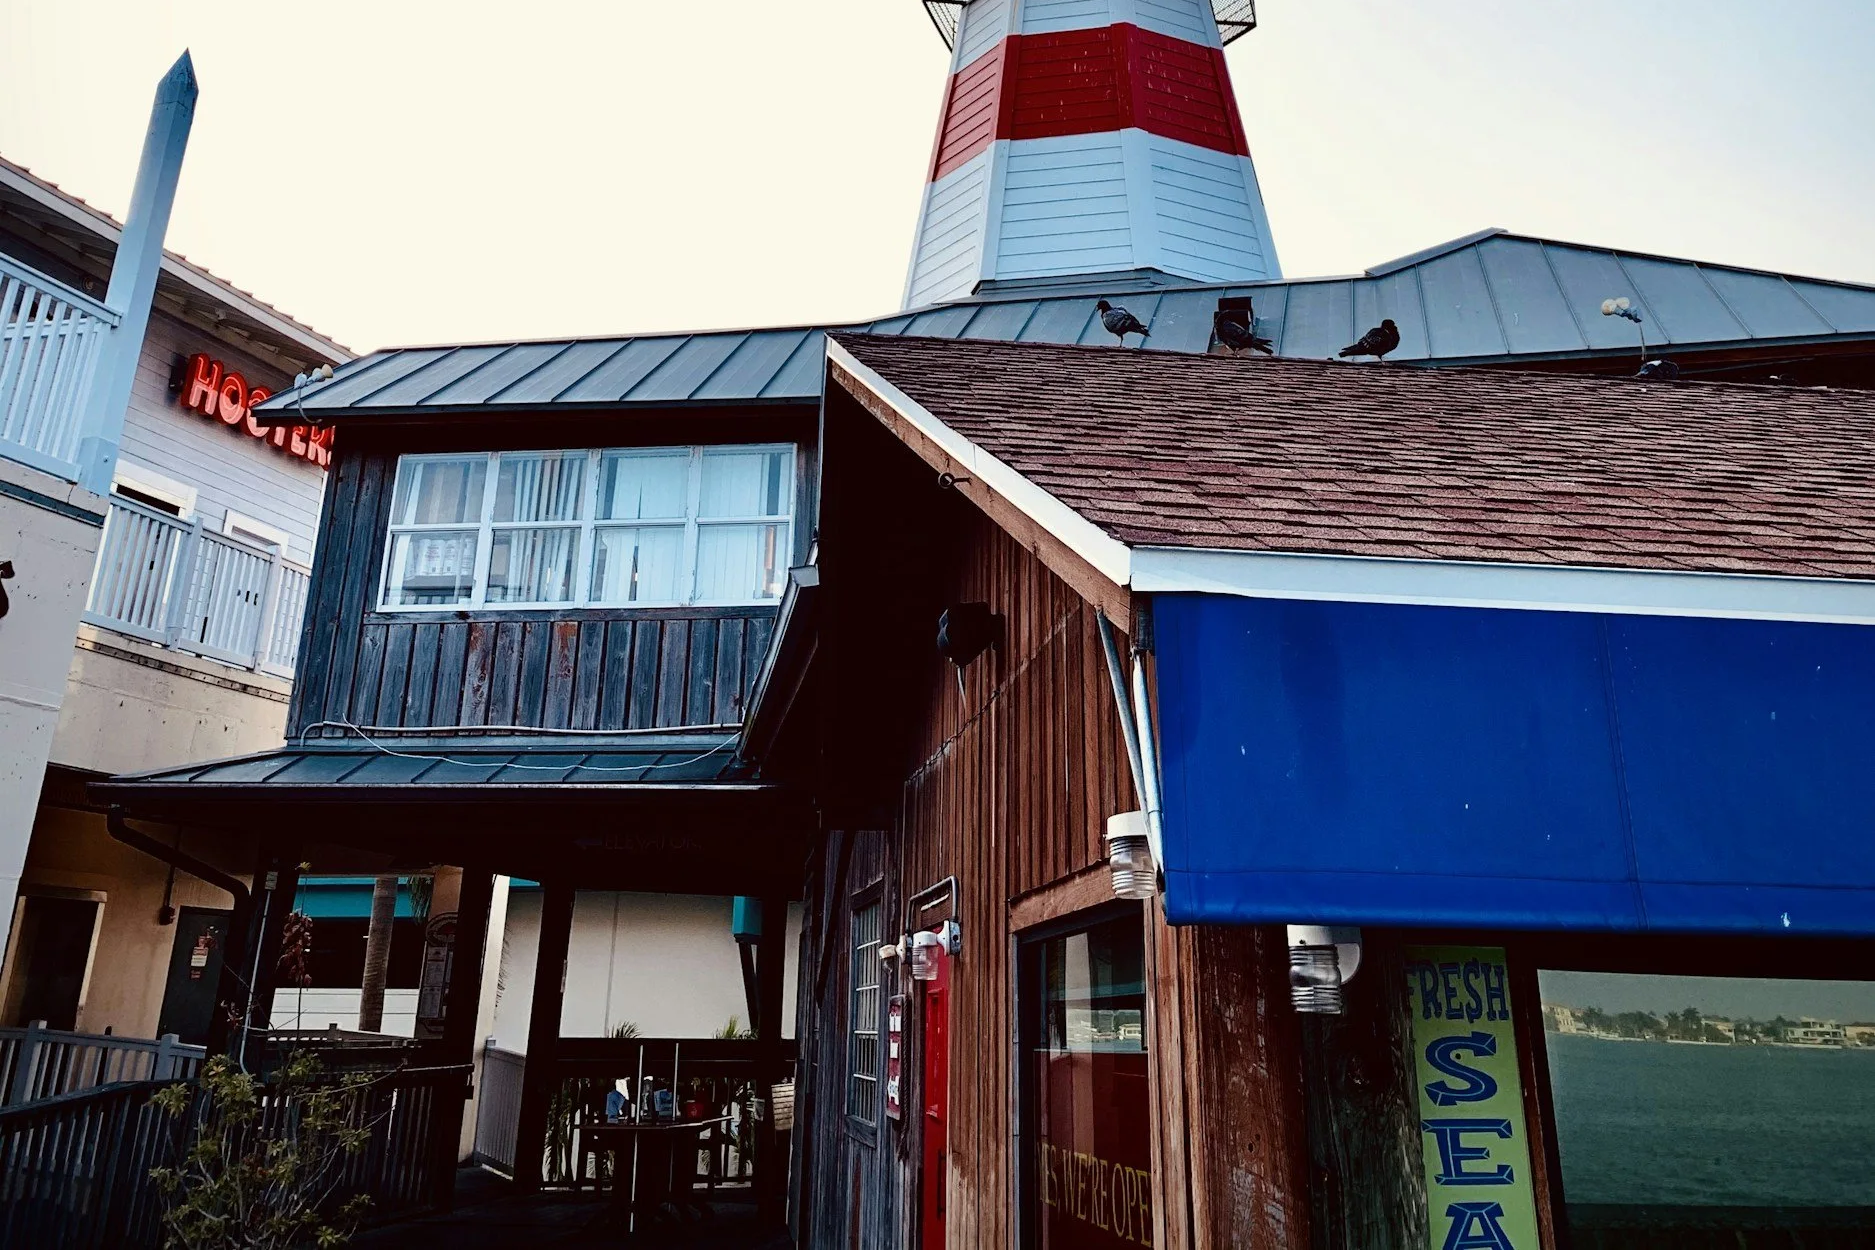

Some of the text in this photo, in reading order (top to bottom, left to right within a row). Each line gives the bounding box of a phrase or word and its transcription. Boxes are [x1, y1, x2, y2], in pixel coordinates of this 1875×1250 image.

[181, 353, 334, 469] HOOER
[1062, 1149, 1109, 1231] WE'RE
[1112, 1163, 1152, 1248] OPE
